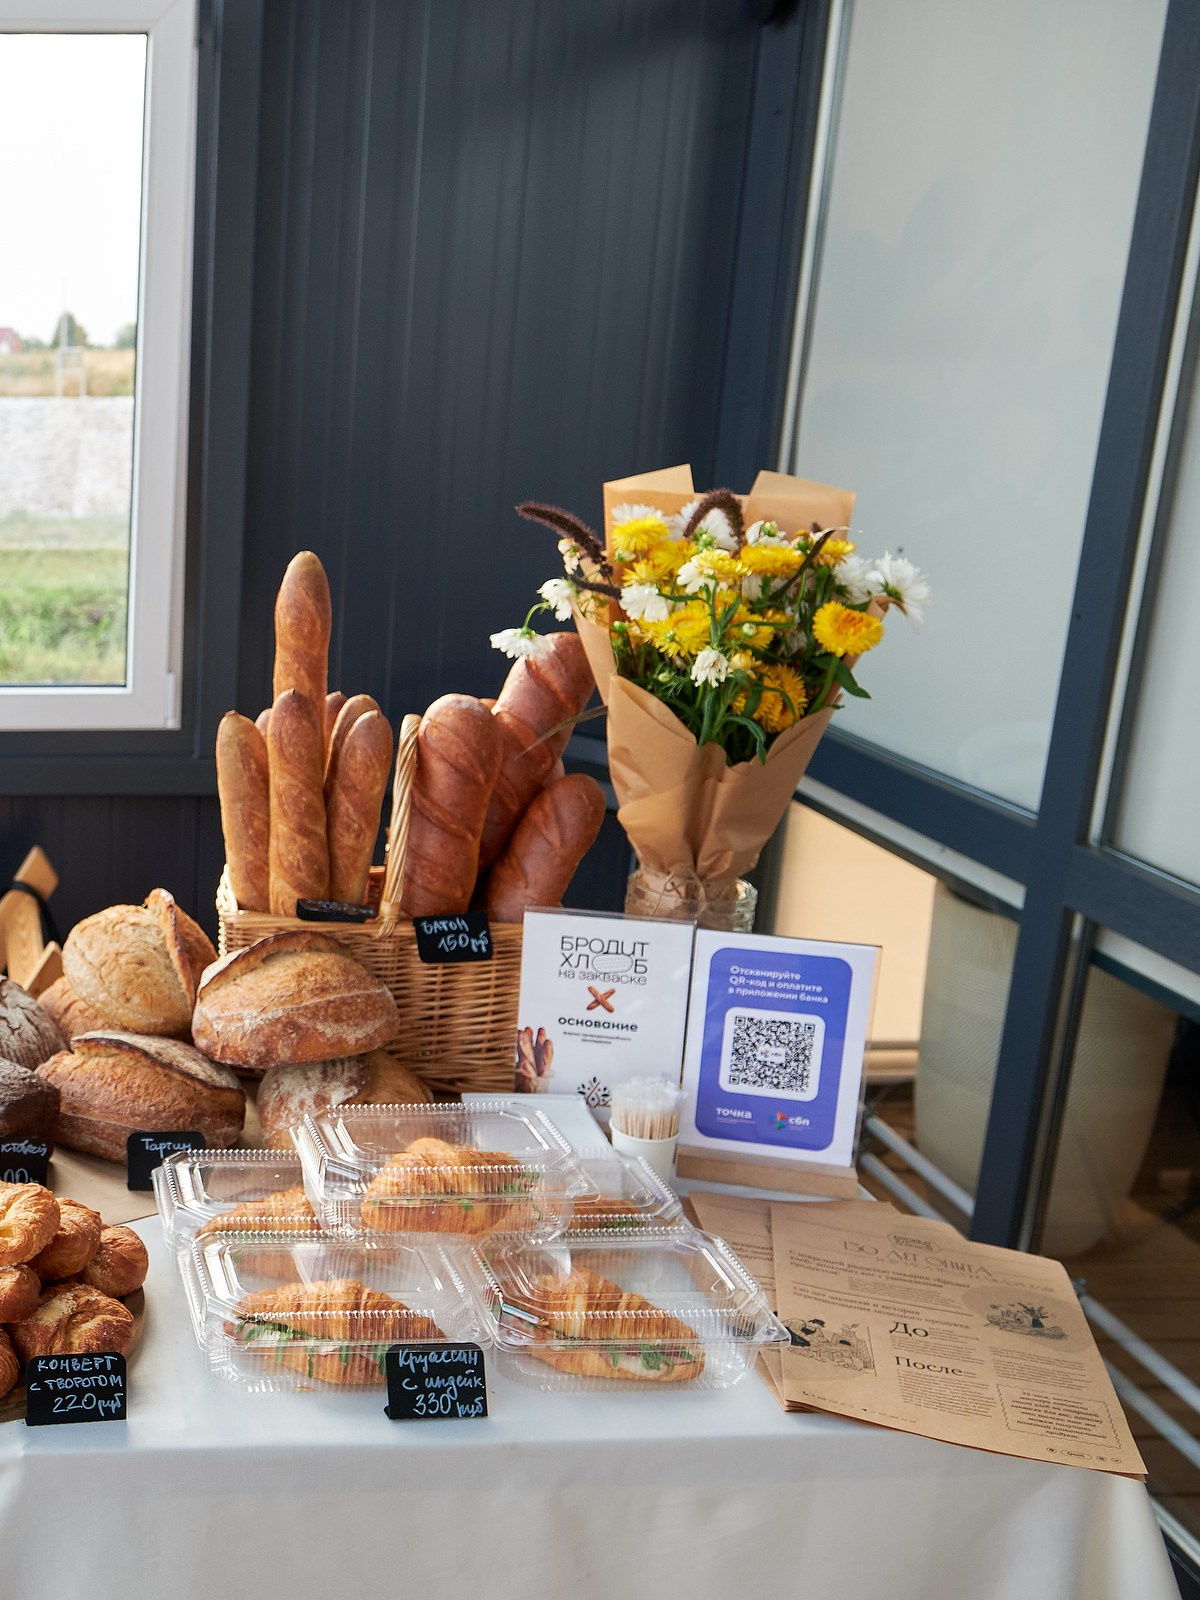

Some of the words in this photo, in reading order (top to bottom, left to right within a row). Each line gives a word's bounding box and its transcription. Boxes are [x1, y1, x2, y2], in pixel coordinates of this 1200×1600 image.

[438, 932, 469, 953] 150
[558, 969, 576, 980] на
[579, 970, 648, 986] закваске
[729, 965, 801, 981] Отсканируйте
[729, 975, 768, 989] QR-код
[776, 983, 823, 993] оплатите
[736, 987, 798, 1000] приложении
[799, 992, 829, 1004] банка
[558, 1017, 638, 1033] основание
[715, 1106, 752, 1120] точка
[788, 1115, 810, 1127] сбп
[889, 1321, 929, 1338] До
[37, 1356, 118, 1373] КОНВЕРТ
[399, 1348, 478, 1373] Круассан
[895, 1355, 963, 1377] После
[44, 1375, 123, 1391] ТВОРОГОМ
[402, 1378, 418, 1390] с
[52, 1393, 97, 1413] 220
[98, 1393, 124, 1416] руб
[413, 1392, 451, 1416] 330
[456, 1396, 484, 1418] руб
